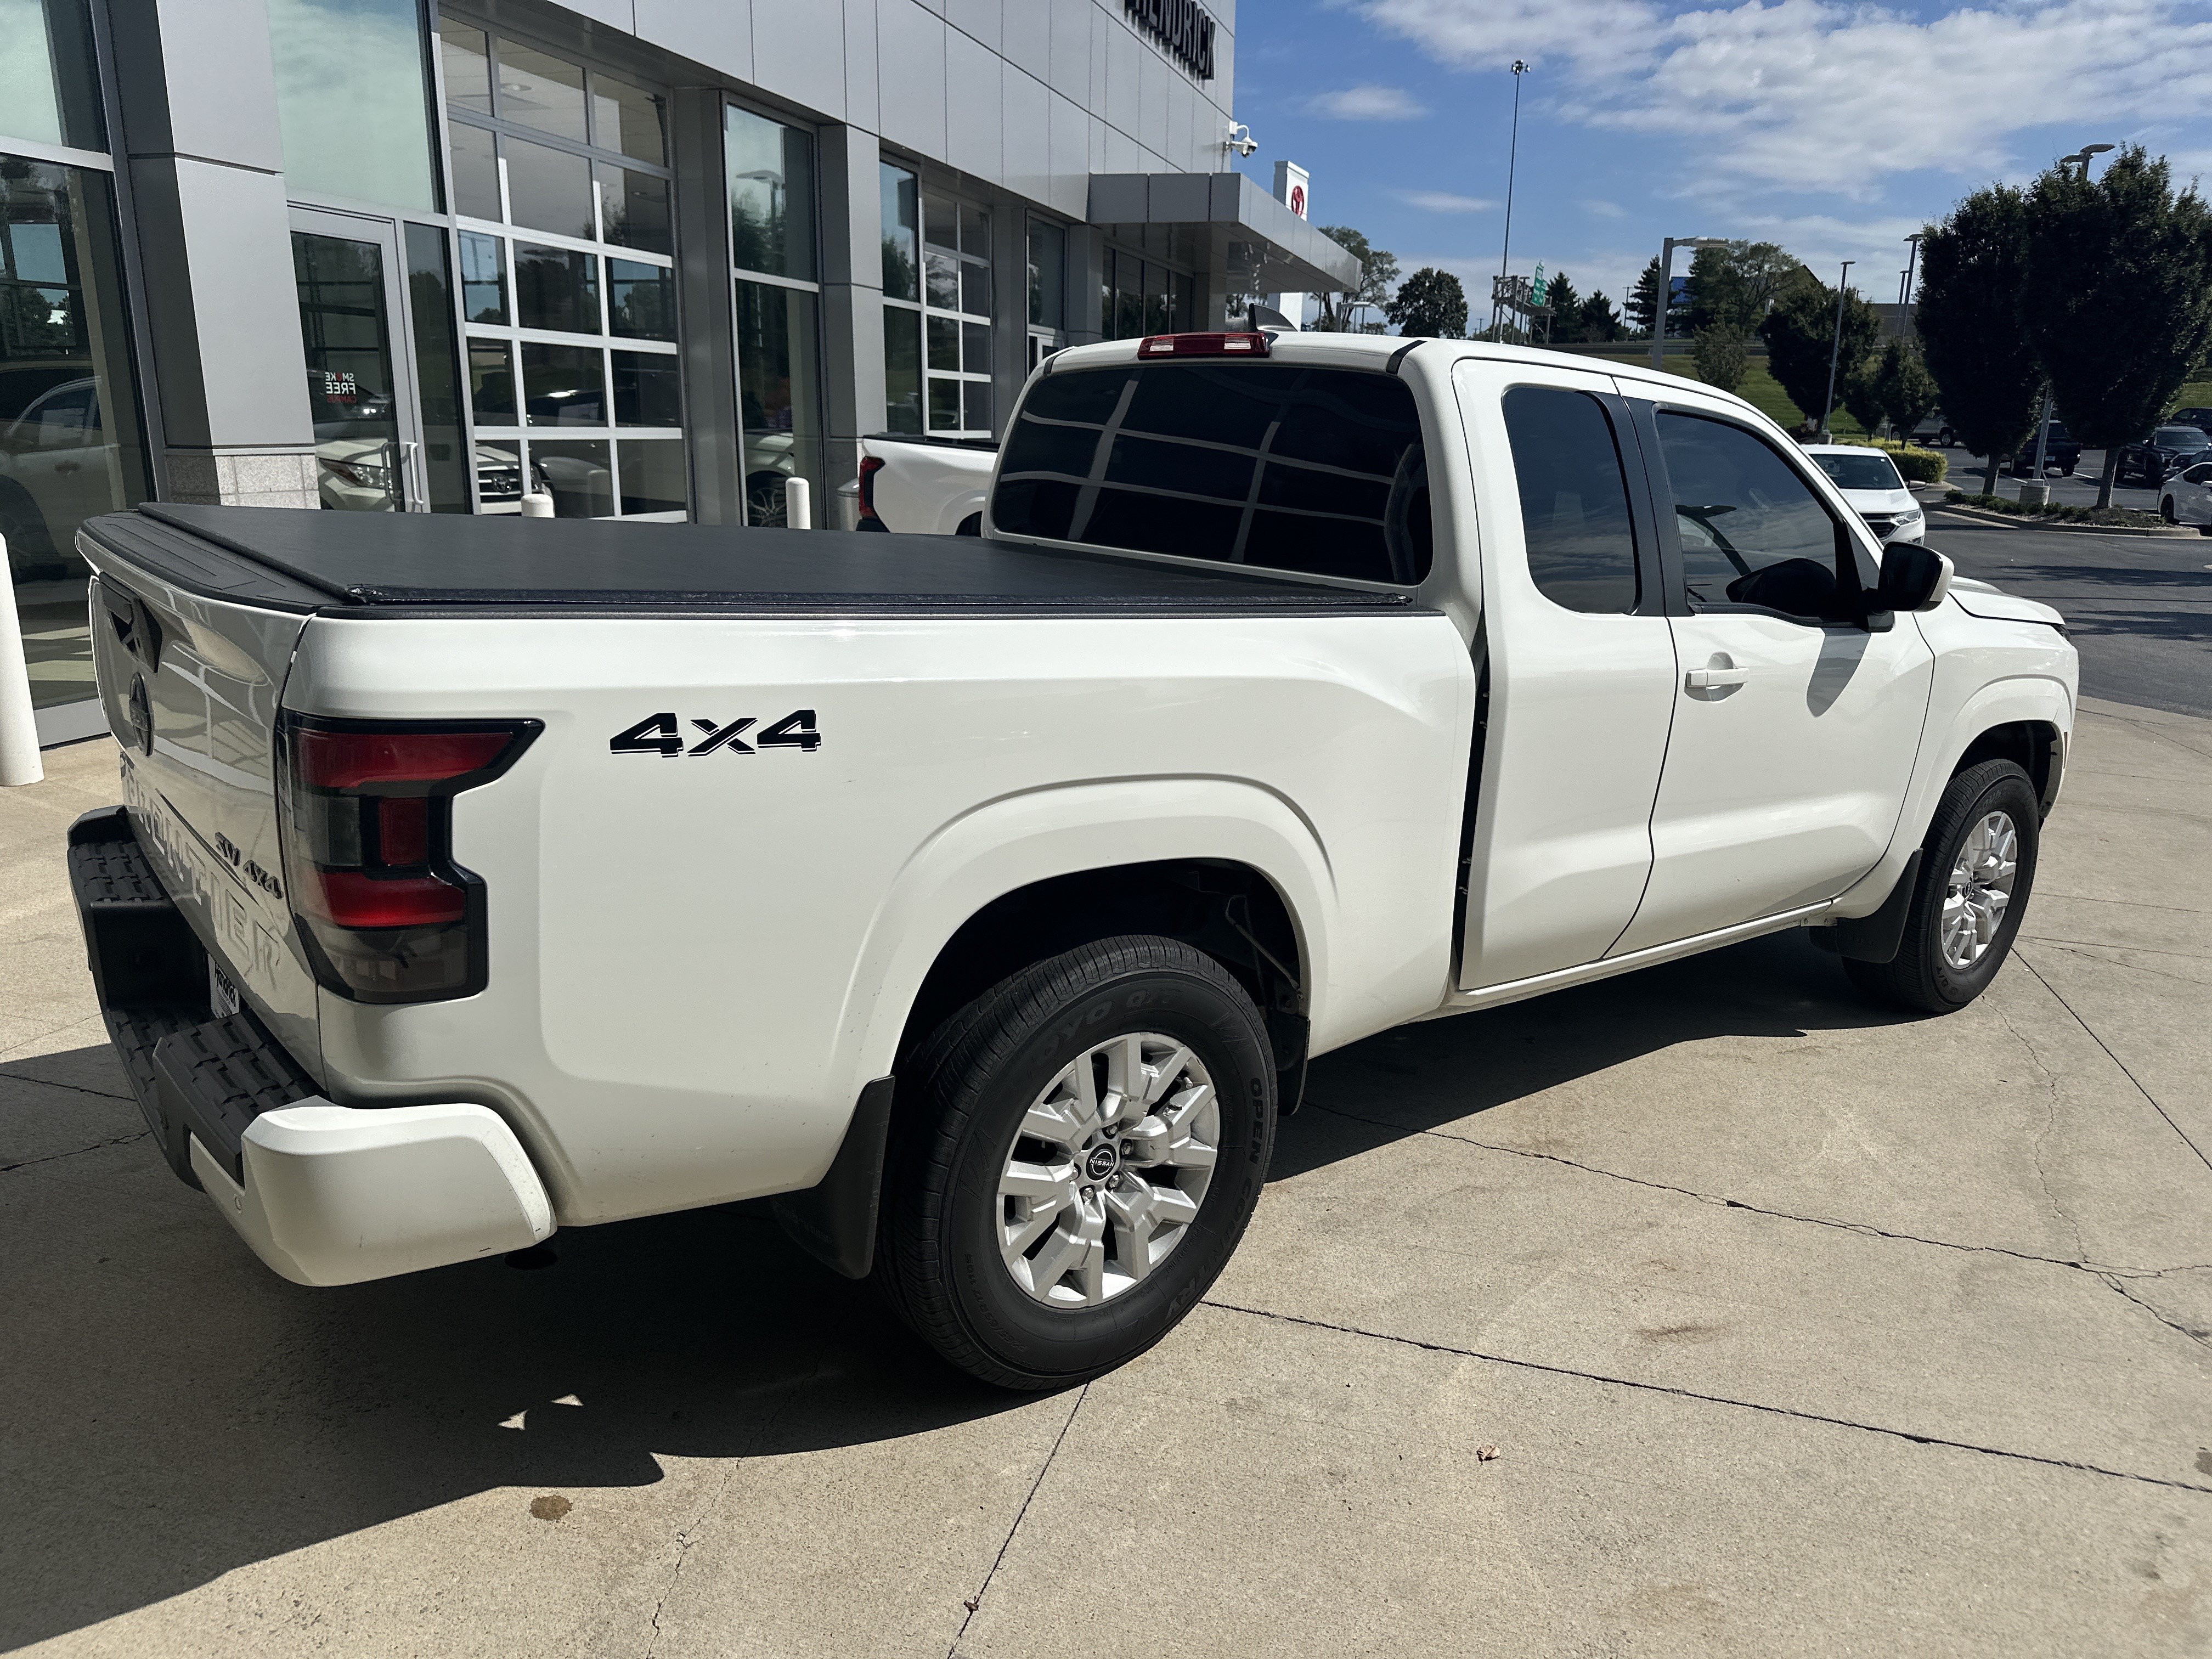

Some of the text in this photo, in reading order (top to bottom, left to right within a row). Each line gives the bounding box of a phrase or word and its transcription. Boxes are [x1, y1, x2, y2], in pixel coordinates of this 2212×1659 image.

[1026, 1000, 1114, 1081] OYO
[1249, 1077, 1263, 1165] OPEN
[1089, 1159, 1115, 1167] NISSAN
